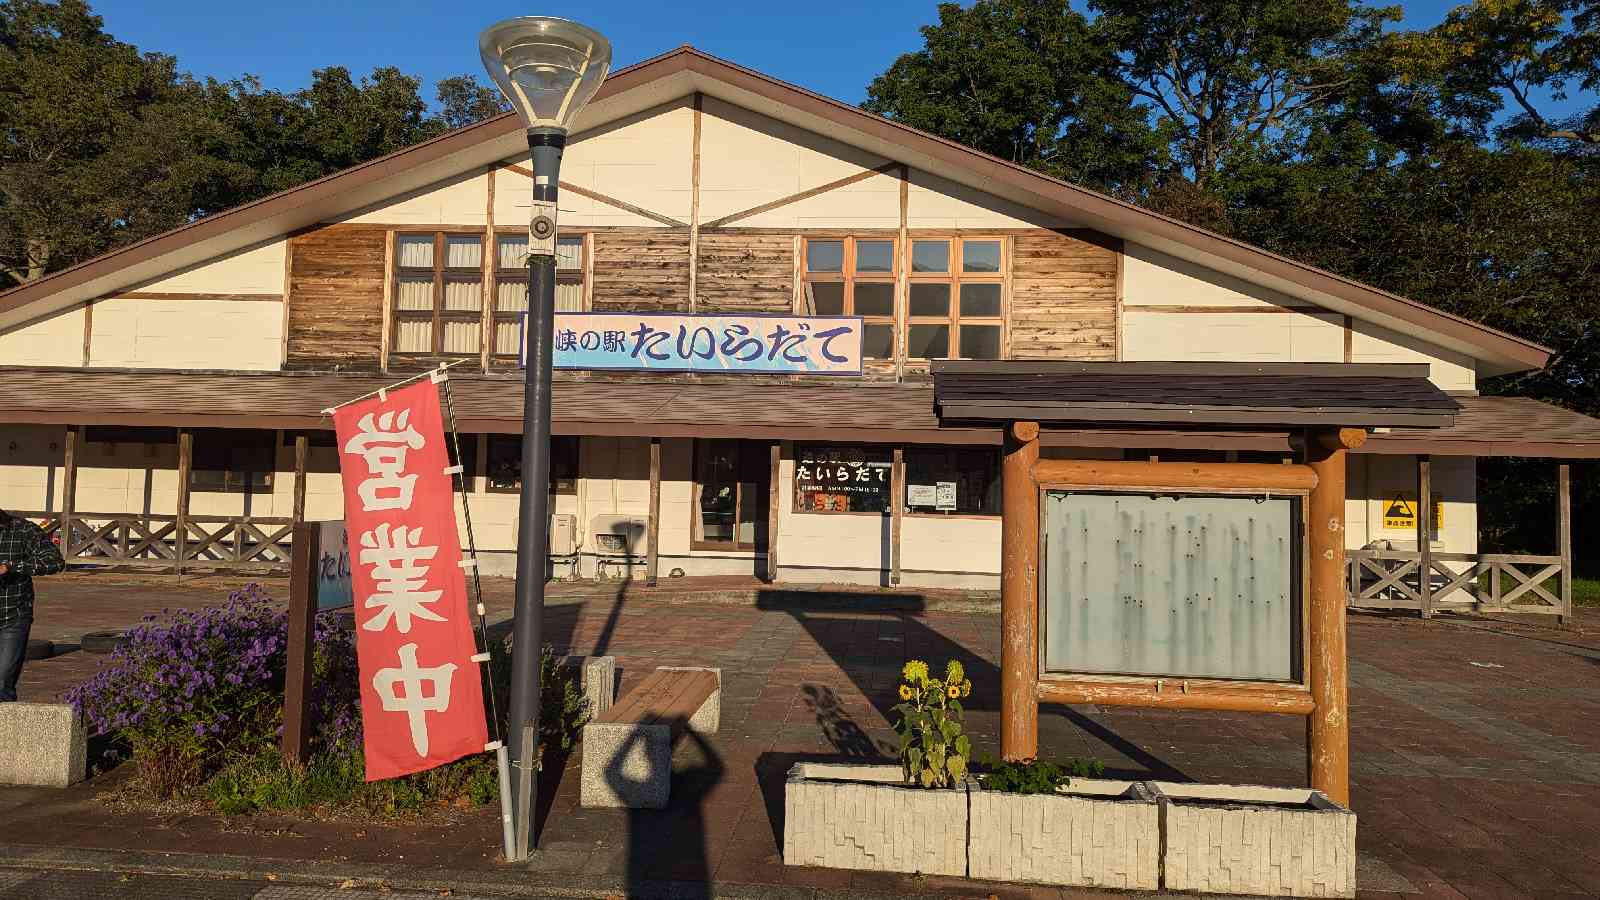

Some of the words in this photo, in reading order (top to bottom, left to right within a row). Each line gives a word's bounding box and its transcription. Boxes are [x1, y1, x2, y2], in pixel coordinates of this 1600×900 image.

[555, 328, 626, 353] 峡の駅
[631, 322, 853, 363] たいらだて
[797, 465, 887, 482] たいらだて
[344, 408, 458, 758] 営業中
